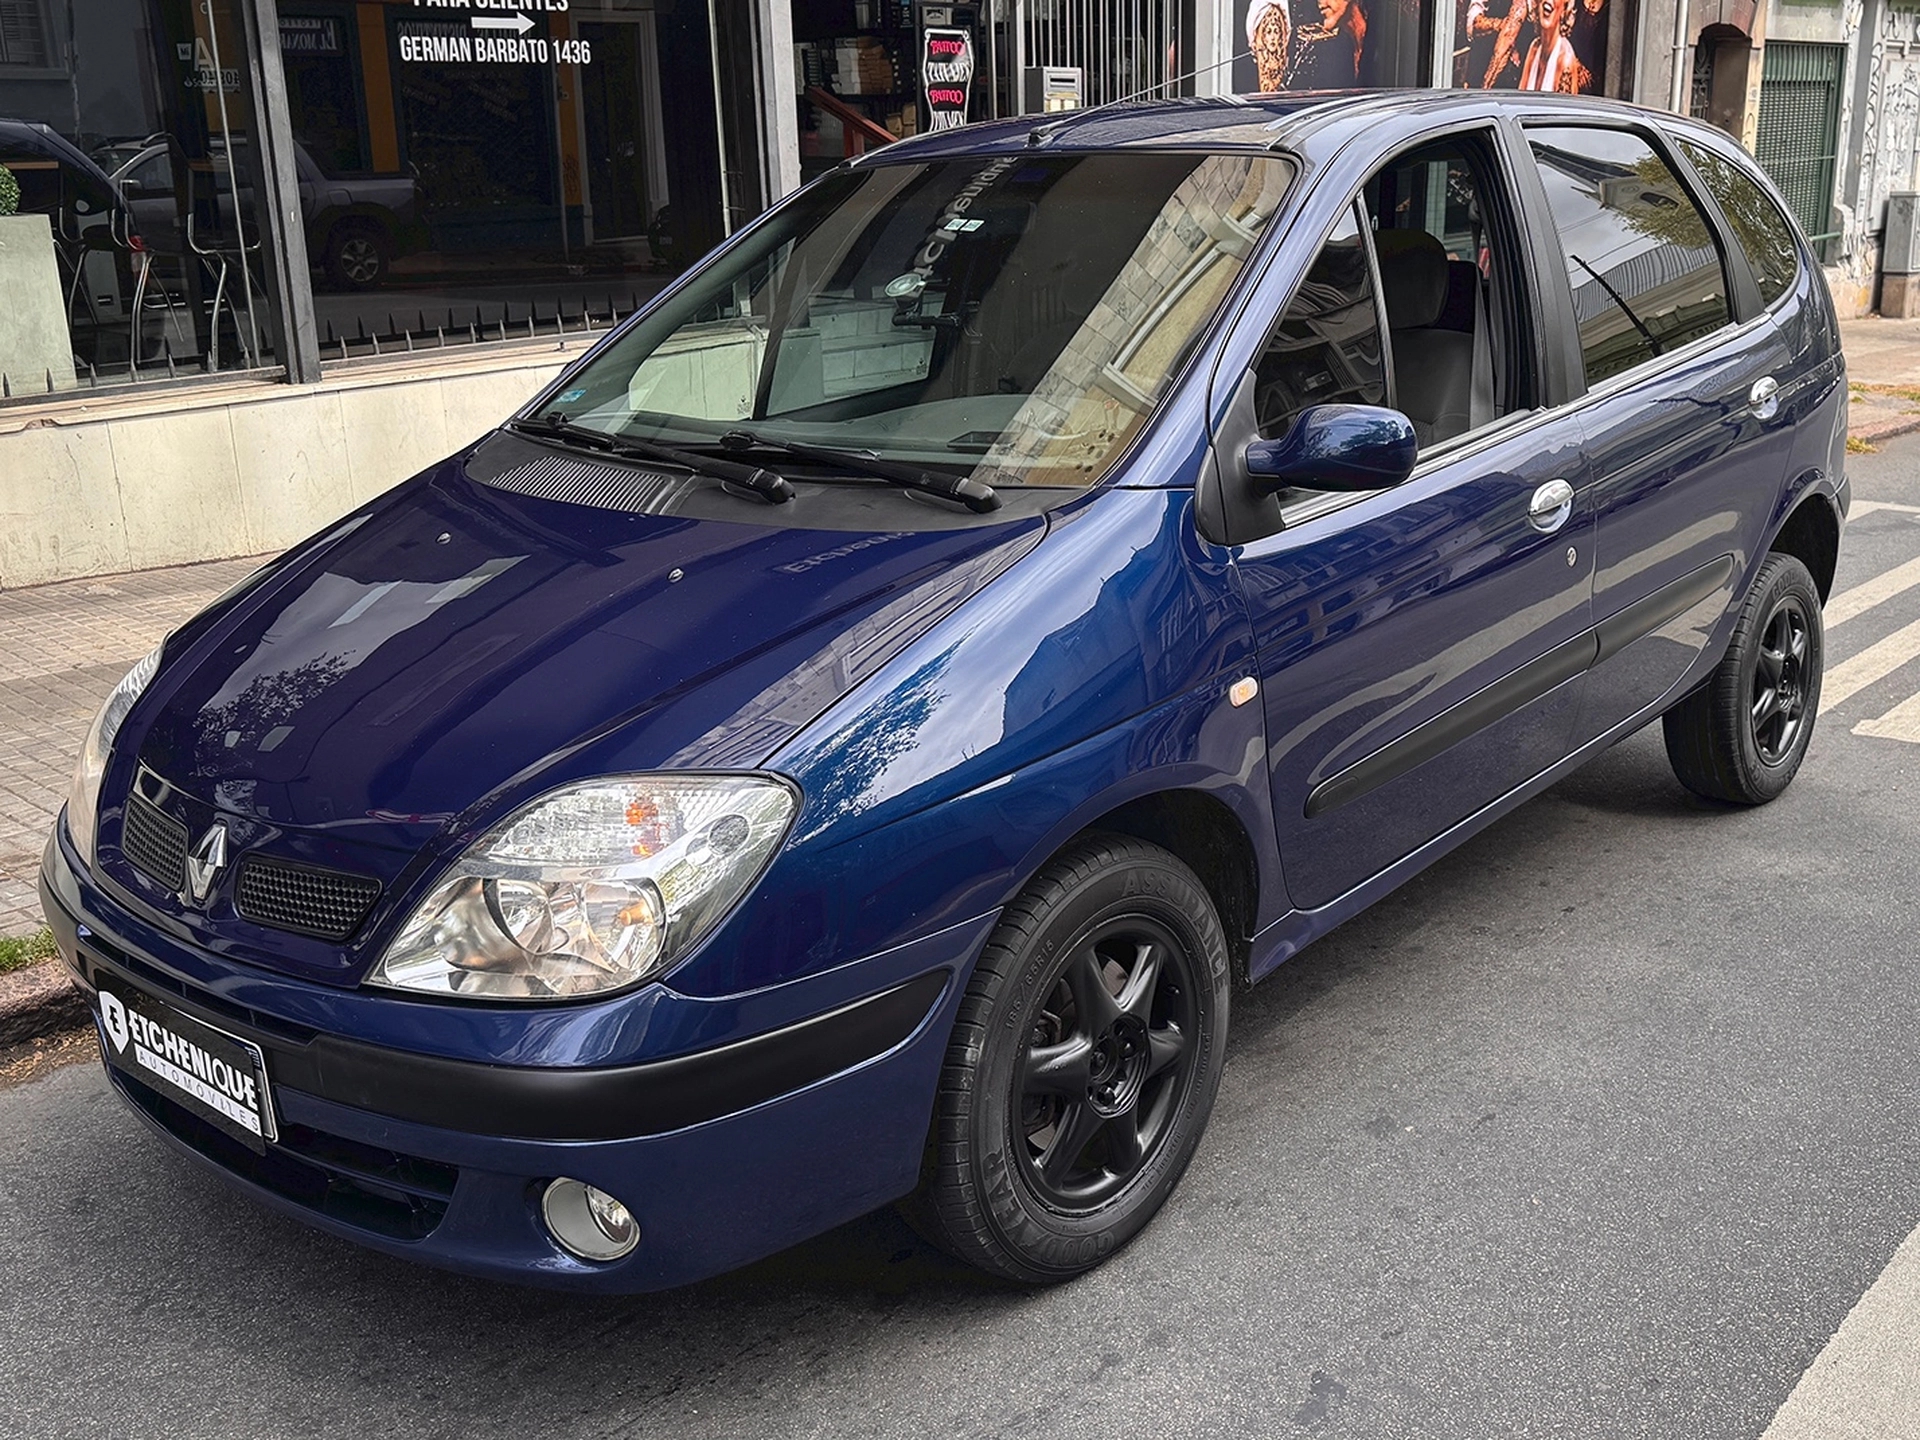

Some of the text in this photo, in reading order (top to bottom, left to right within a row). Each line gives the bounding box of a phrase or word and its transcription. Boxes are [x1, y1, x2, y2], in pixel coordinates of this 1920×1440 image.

[400, 36, 592, 65] GERMAN BARBATO 1436
[929, 89, 964, 105] TATTOO
[128, 1008, 259, 1112] ETCHENIQUE
